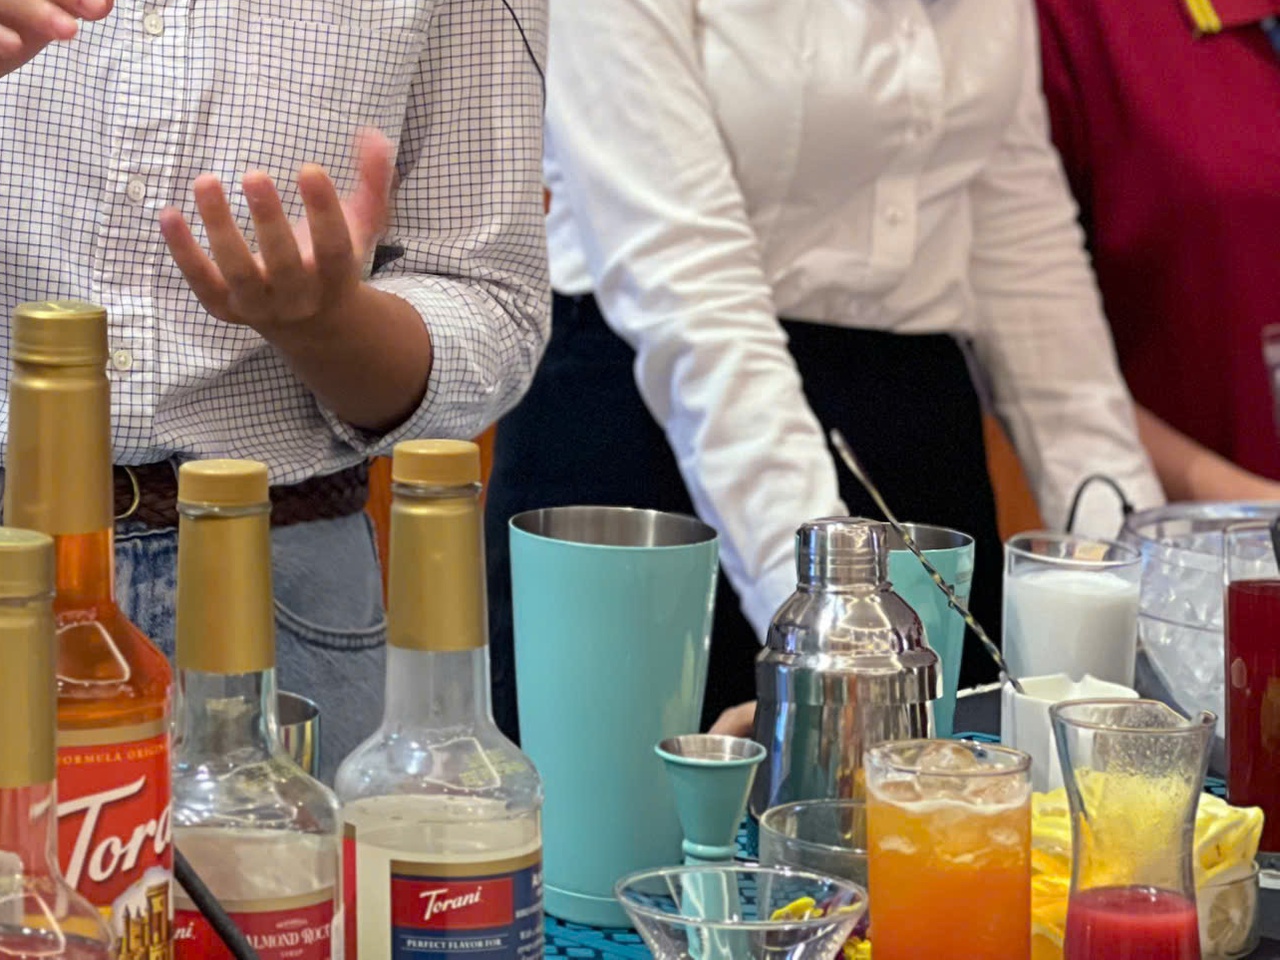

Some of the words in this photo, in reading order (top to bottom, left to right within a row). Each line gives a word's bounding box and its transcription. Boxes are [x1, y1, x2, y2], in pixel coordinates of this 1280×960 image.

[57, 751, 122, 765] ORMULA
[419, 886, 482, 921] Torani
[406, 938, 446, 949] PERFECT
[448, 940, 483, 950] FLAVOR
[485, 938, 502, 947] FOR
